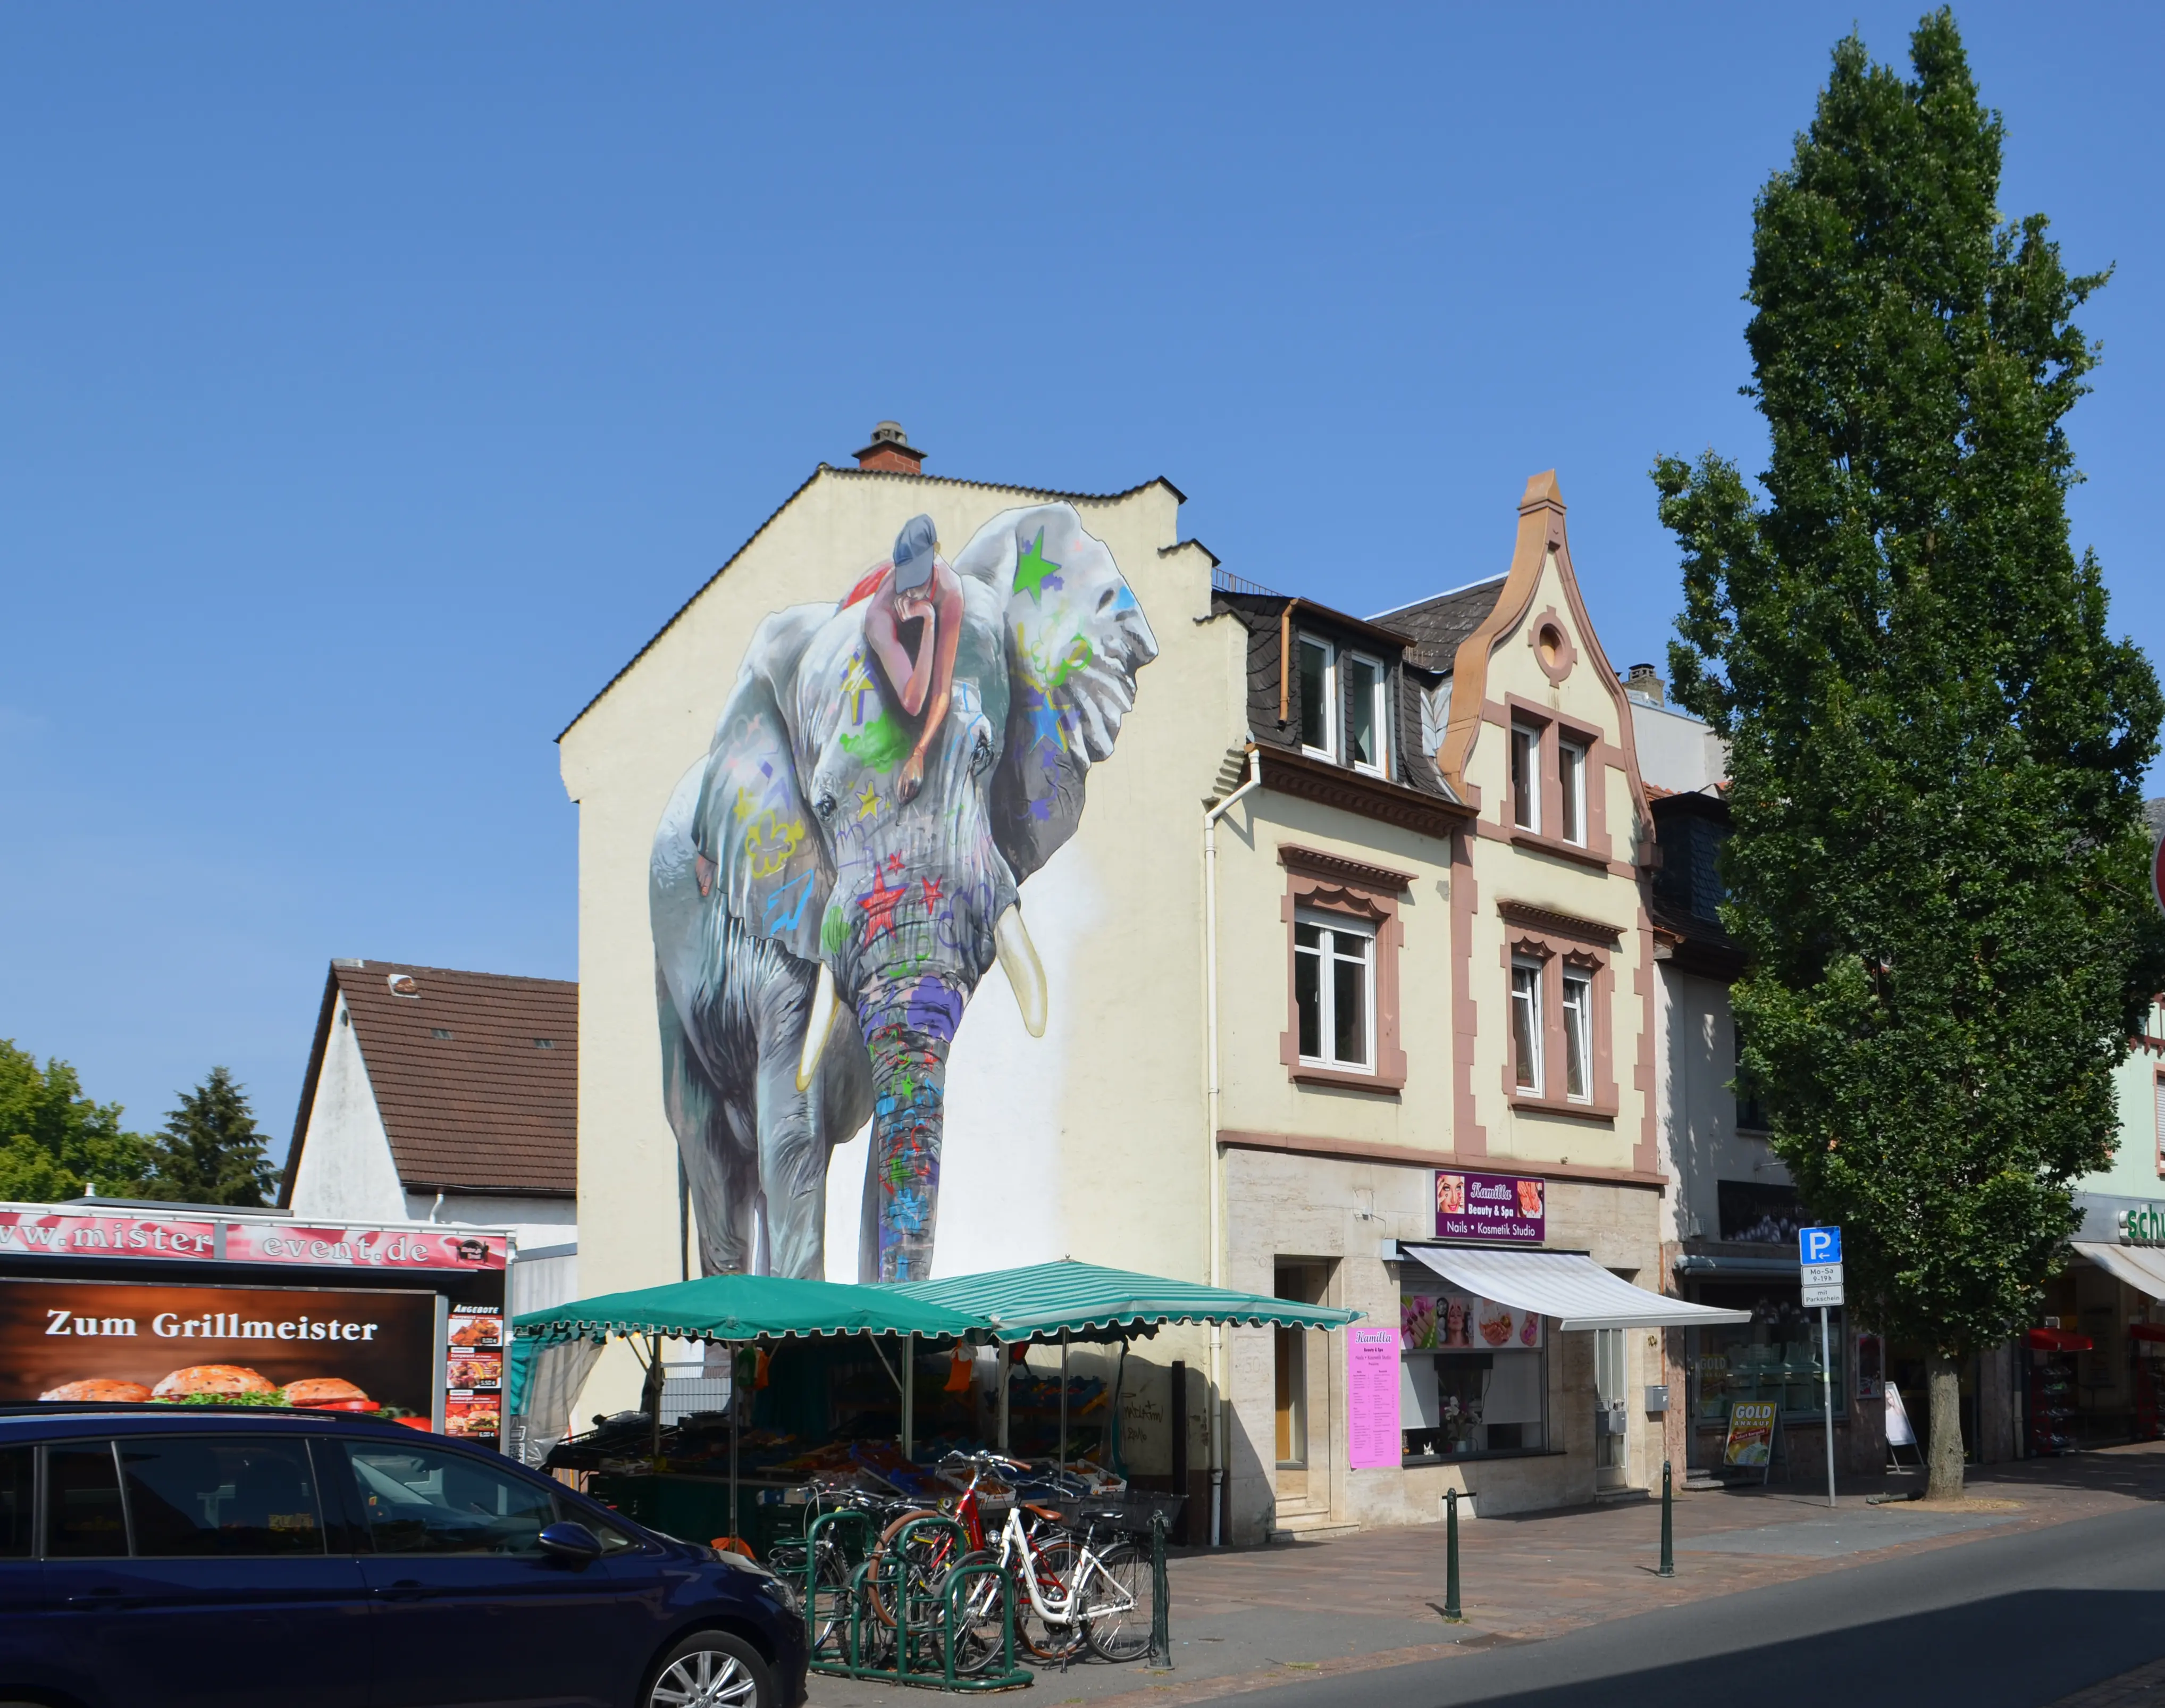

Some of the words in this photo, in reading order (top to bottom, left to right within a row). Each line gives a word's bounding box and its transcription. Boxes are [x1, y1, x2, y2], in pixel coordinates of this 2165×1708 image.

[1470, 1182, 1512, 1200] Kamilla
[1468, 1203, 1492, 1218] Beauty
[1493, 1205, 1500, 1216] &
[1501, 1205, 1514, 1219] Spa
[1447, 1220, 1467, 1233] Nails
[1478, 1222, 1511, 1235] Kosmetik
[1512, 1223, 1535, 1236] Studio
[262, 1236, 429, 1261] event.de
[1809, 1232, 1831, 1260] P
[45, 1309, 138, 1336] Zum
[152, 1312, 379, 1341] Grillmeister
[1355, 1331, 1392, 1344] Kamilla
[1735, 1405, 1772, 1419] GOLD
